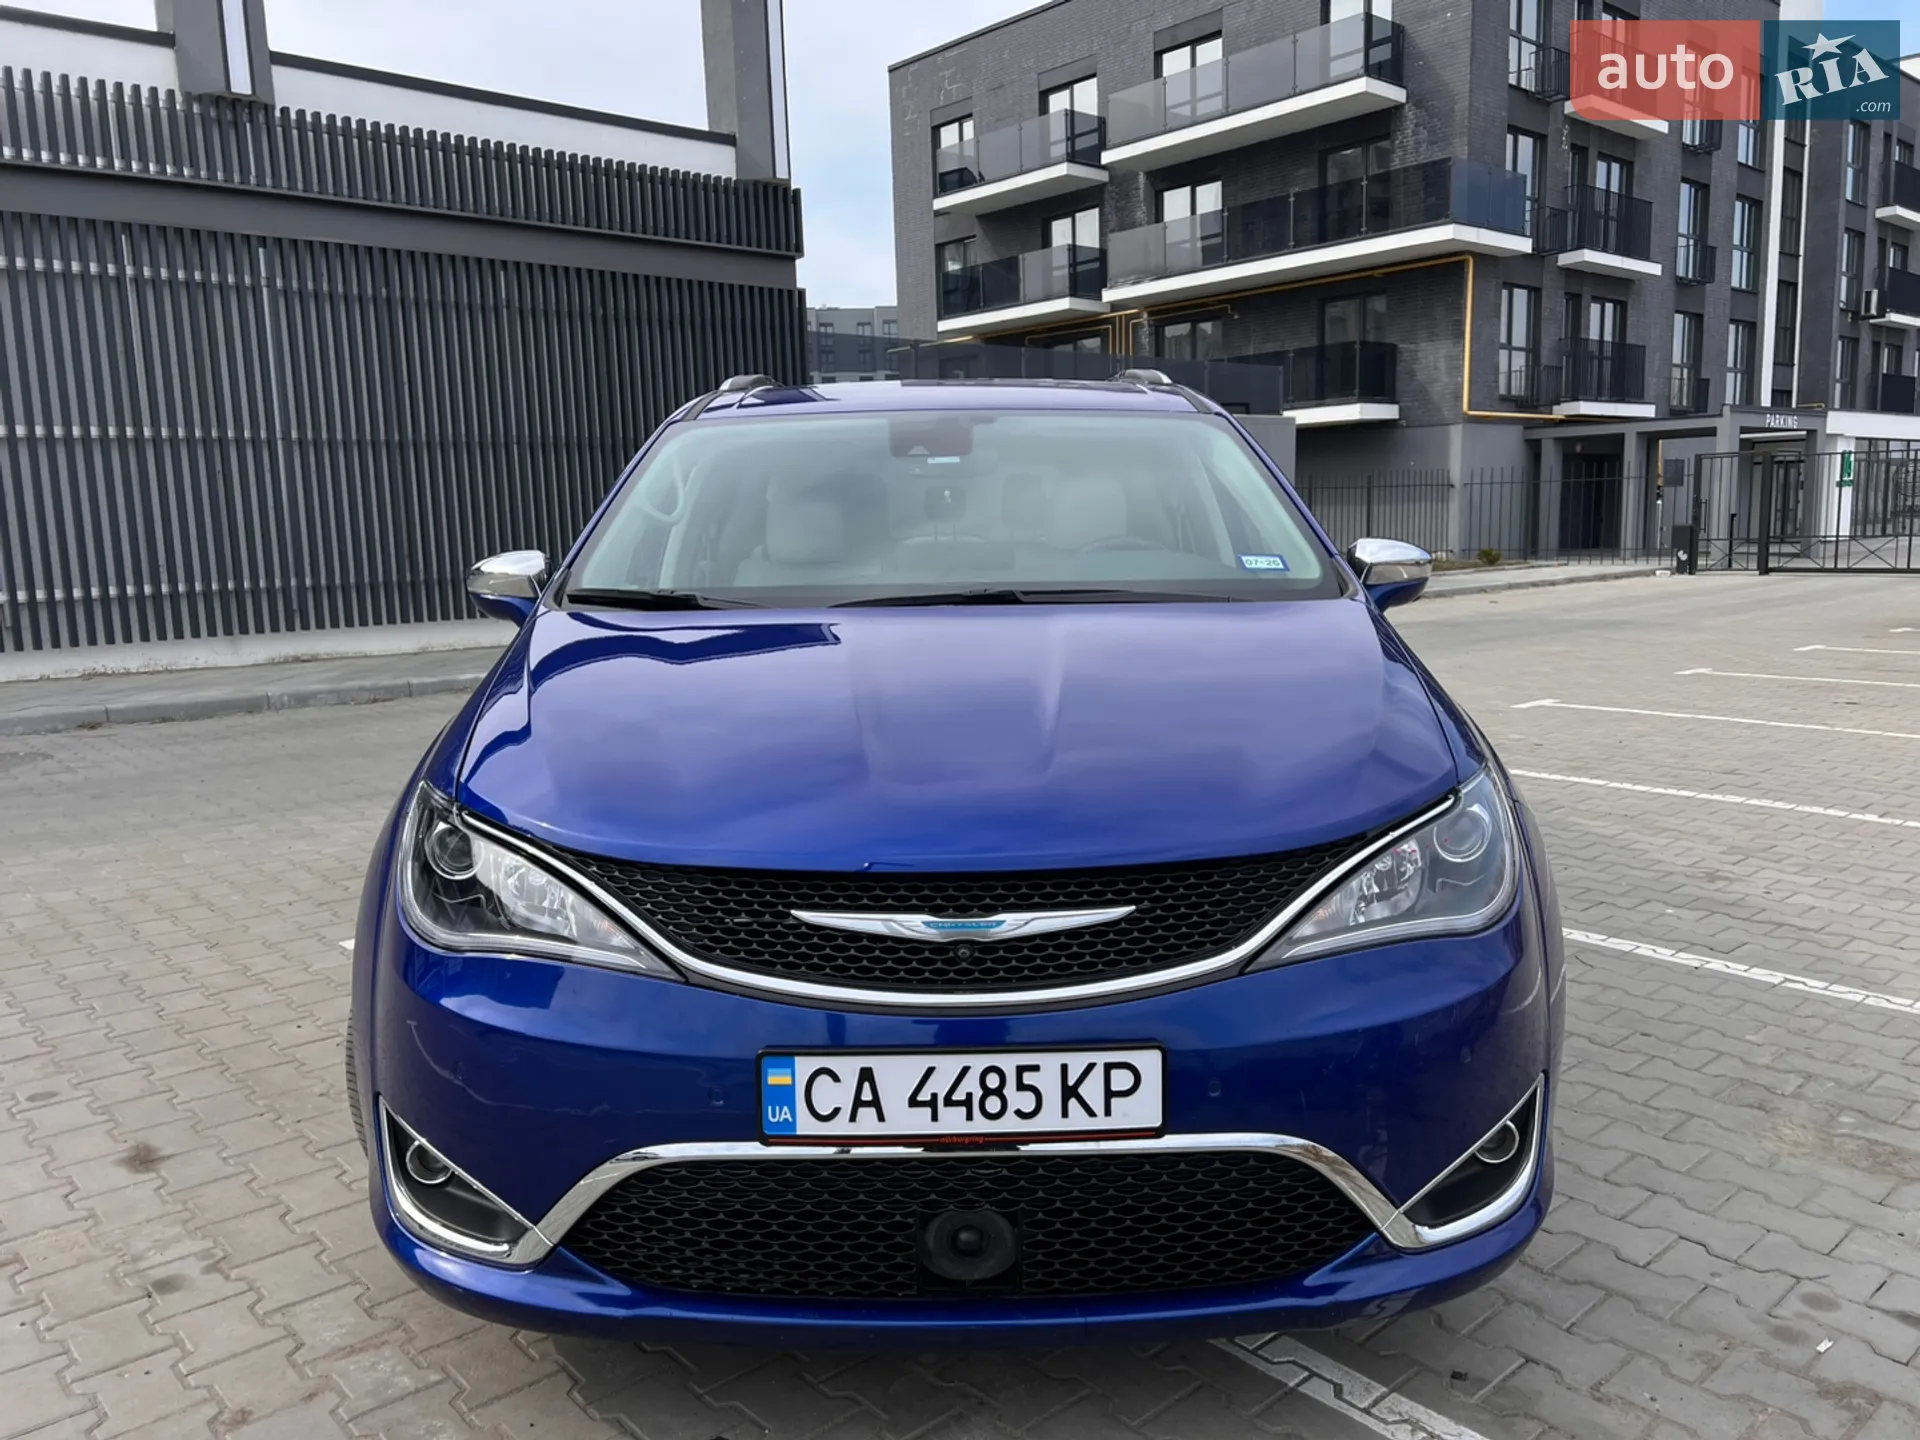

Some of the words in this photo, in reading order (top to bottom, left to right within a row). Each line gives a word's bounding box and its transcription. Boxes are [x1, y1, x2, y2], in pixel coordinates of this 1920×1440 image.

[1765, 413, 1798, 429] PARKING
[804, 1066, 886, 1123] CA
[908, 1063, 1044, 1122] 4485
[1060, 1061, 1142, 1119] KP
[767, 1105, 793, 1122] UA
